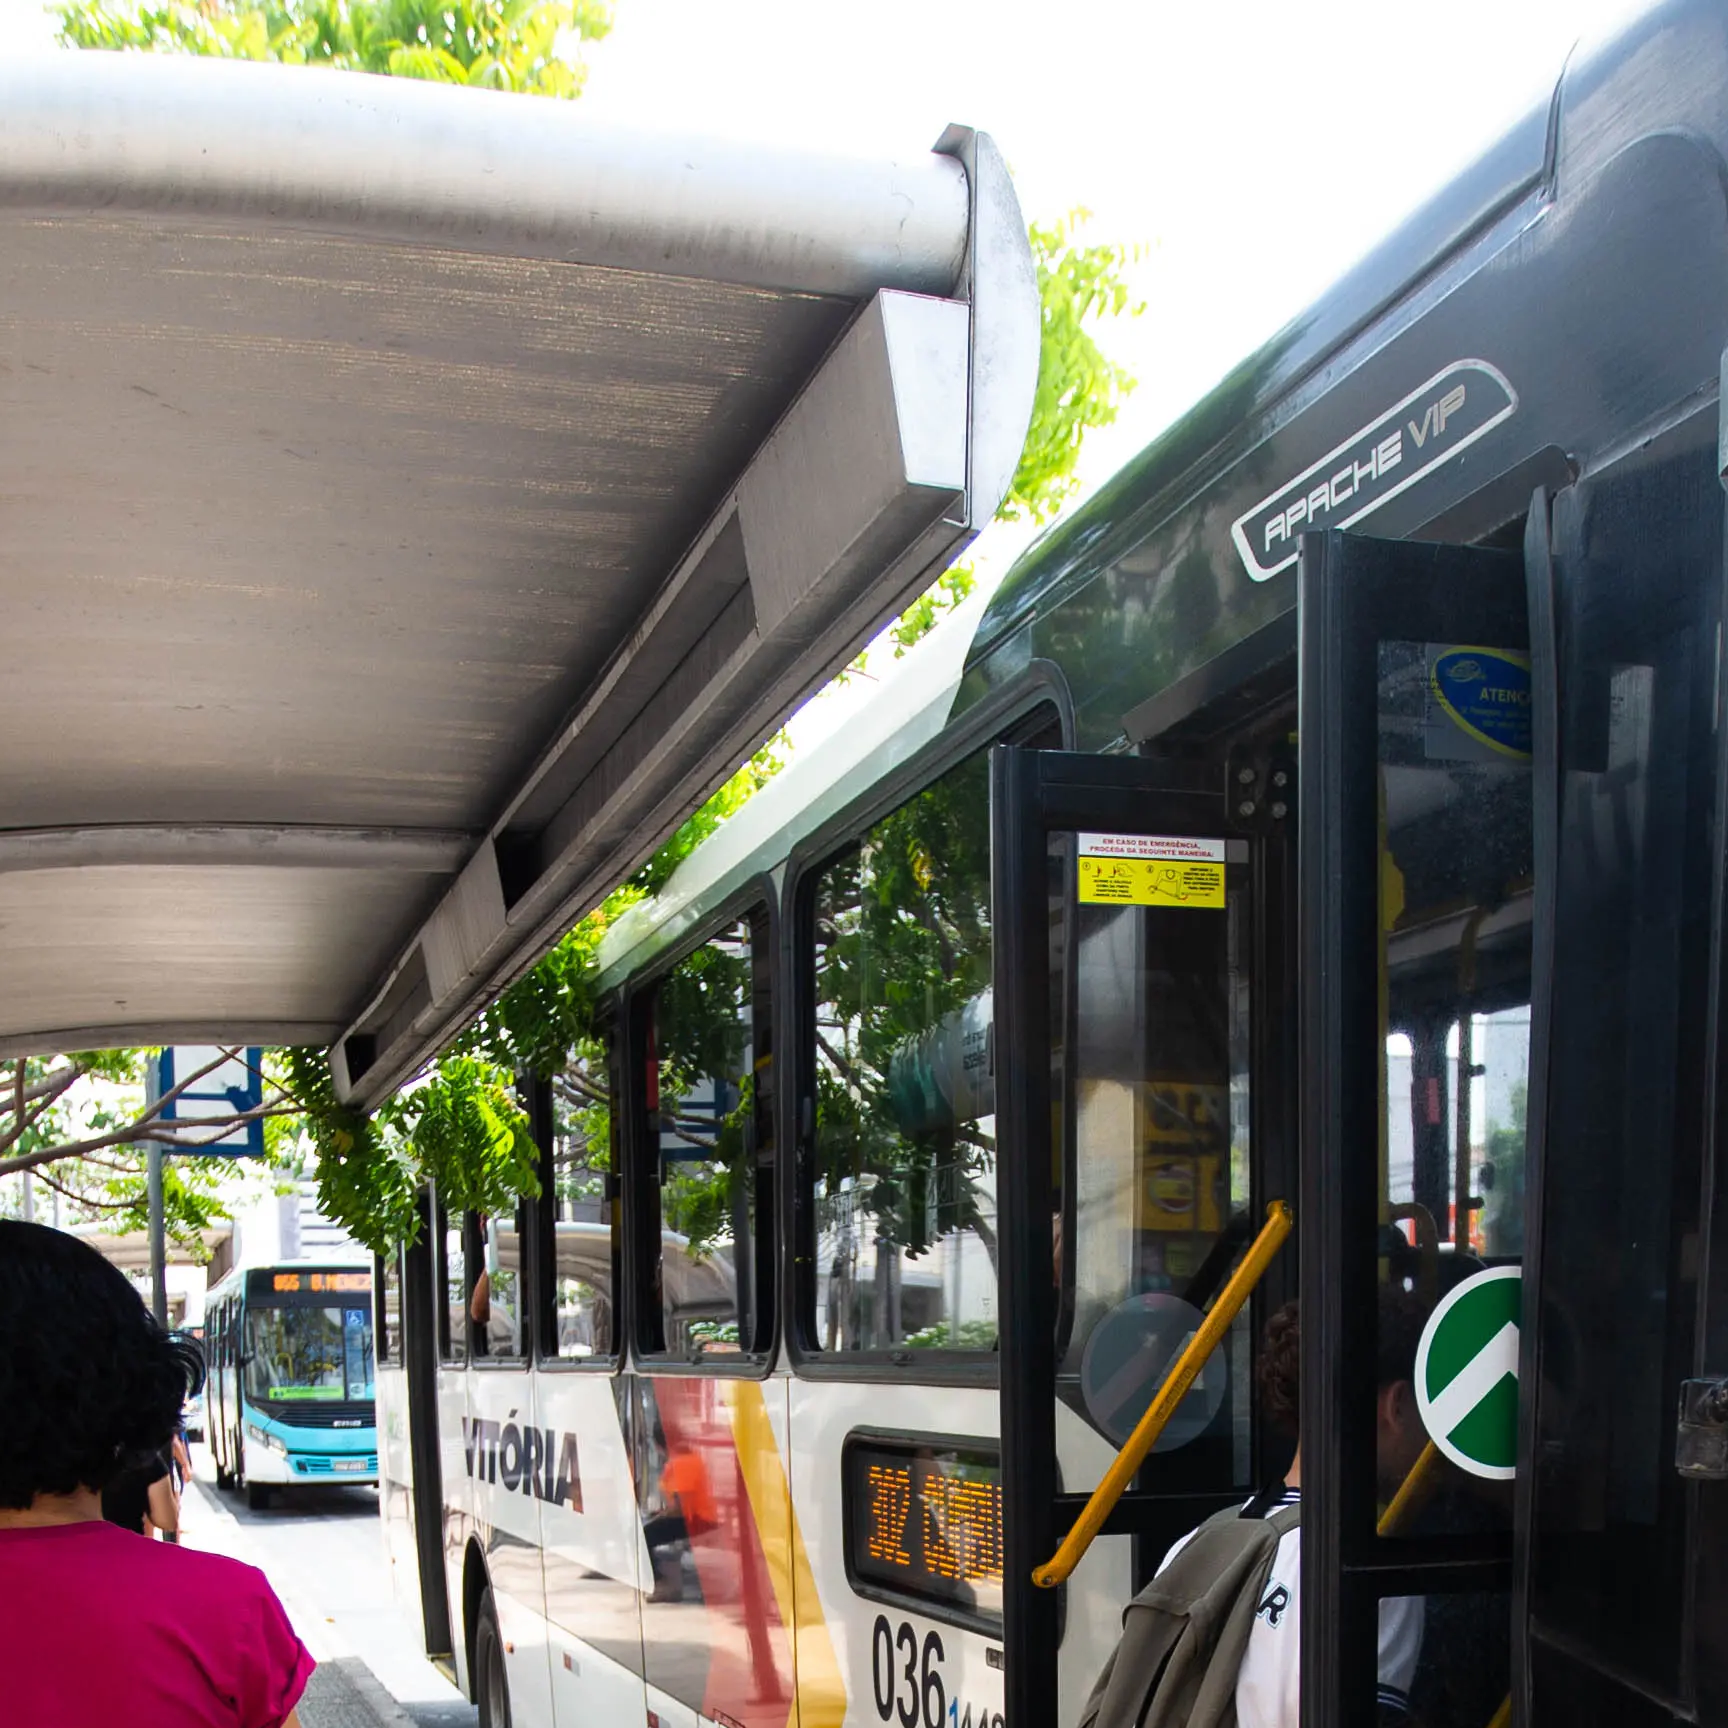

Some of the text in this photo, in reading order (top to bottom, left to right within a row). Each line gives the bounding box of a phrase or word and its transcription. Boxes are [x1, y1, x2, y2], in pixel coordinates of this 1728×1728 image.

[1264, 383, 1466, 553] APACHE VIP
[462, 1408, 584, 1515] VITÓRIA
